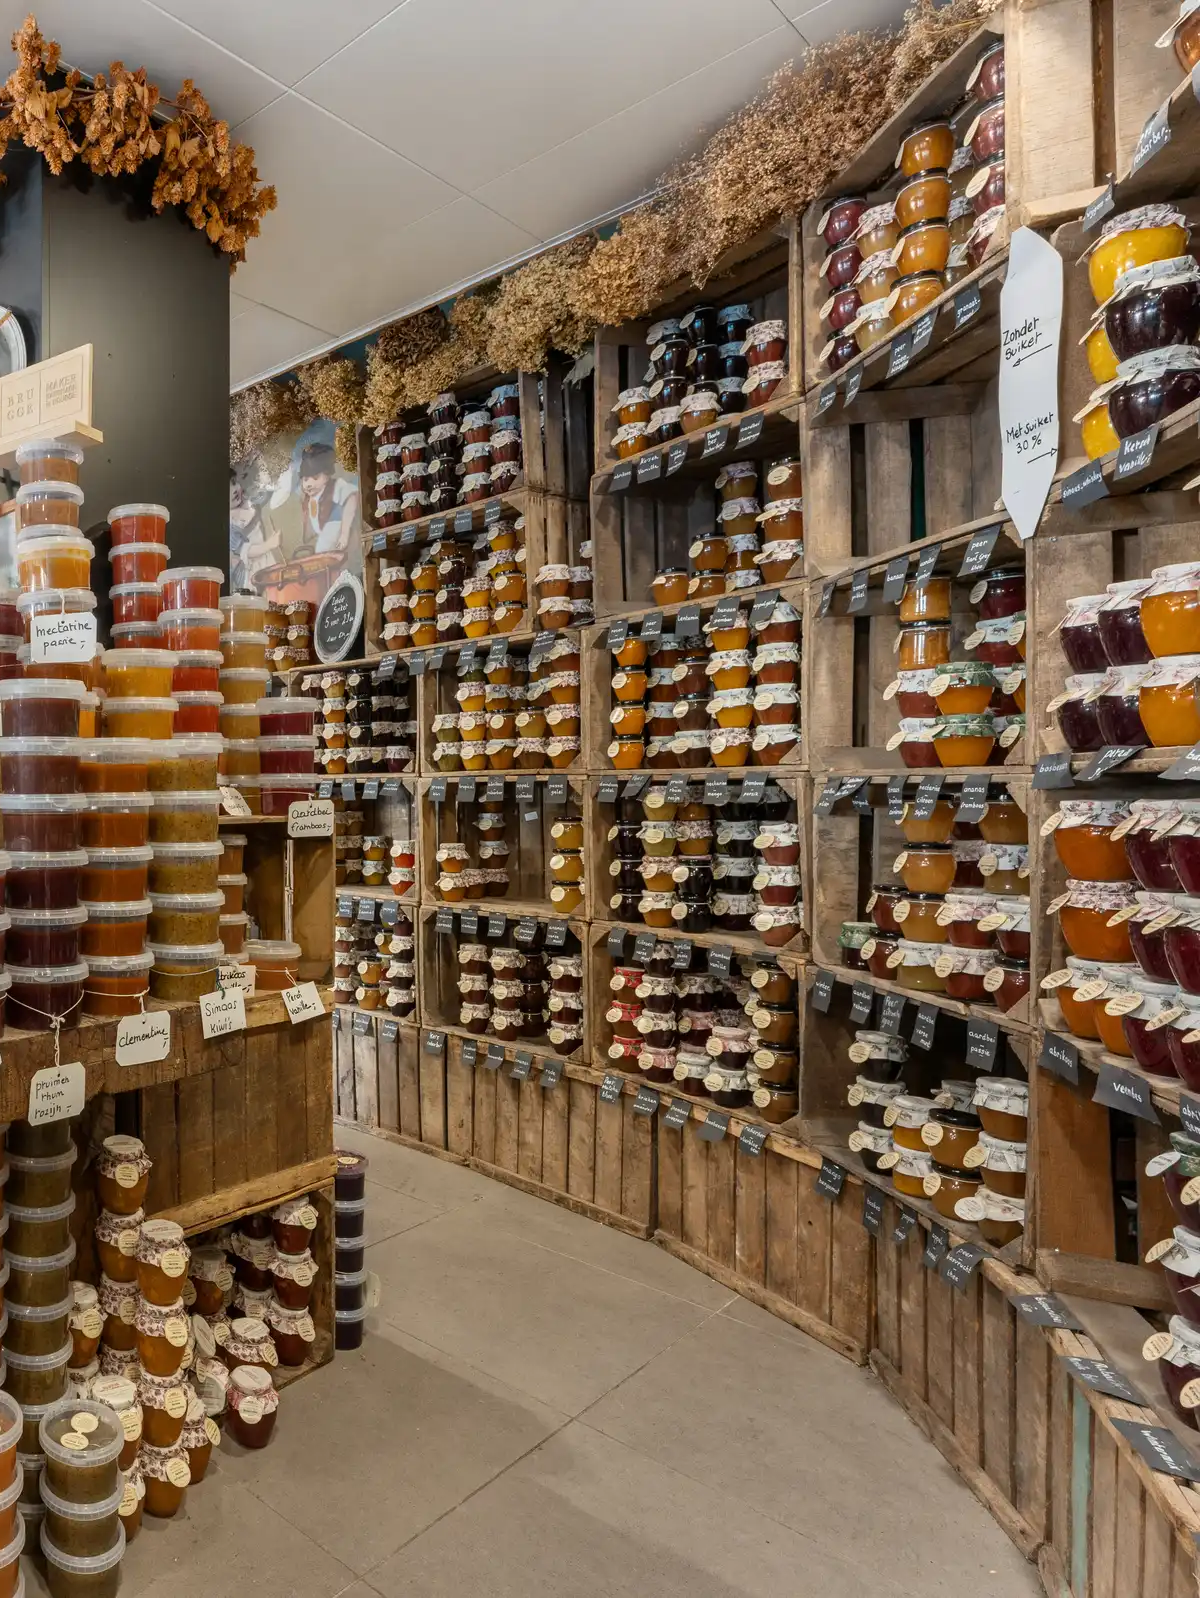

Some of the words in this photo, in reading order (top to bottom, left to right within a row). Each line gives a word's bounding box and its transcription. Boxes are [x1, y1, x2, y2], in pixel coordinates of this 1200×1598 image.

[1006, 427, 1024, 444] Met
[1016, 440, 1030, 454] 30
[1032, 435, 1043, 450] %
[972, 540, 988, 550] peer
[969, 1031, 996, 1043] aardbei
[1049, 1047, 1073, 1068] abrikoos
[41, 1091, 64, 1102] rhum
[956, 1248, 973, 1258] peer
